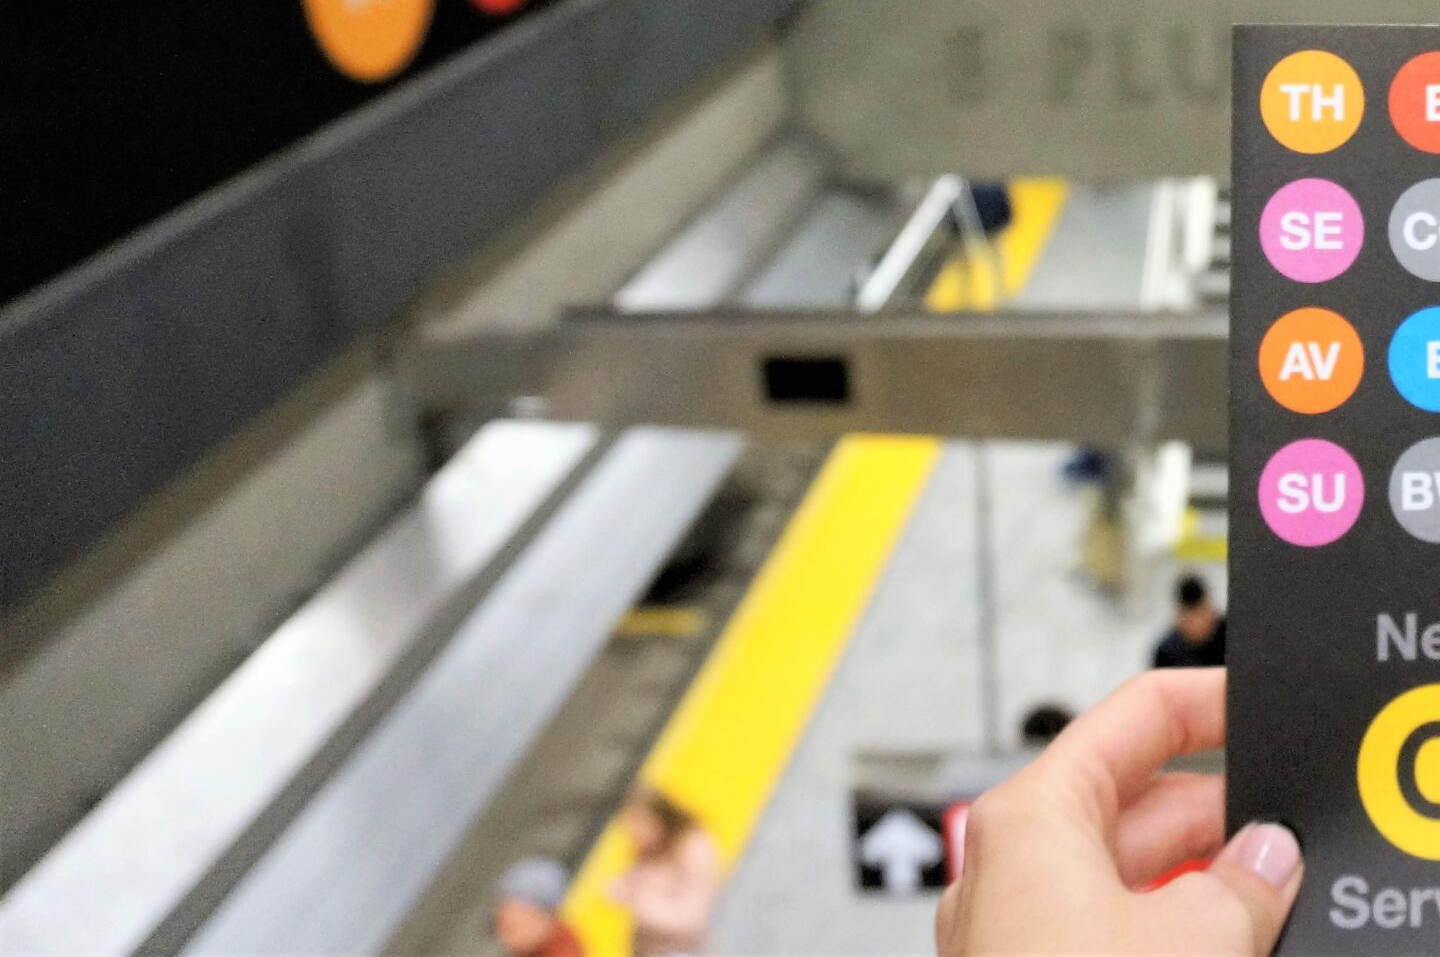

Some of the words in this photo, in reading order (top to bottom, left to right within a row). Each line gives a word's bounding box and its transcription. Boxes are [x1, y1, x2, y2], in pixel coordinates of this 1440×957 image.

[1279, 84, 1345, 122] TH
[1279, 211, 1344, 251] SE
[1278, 342, 1341, 381] AV
[1276, 472, 1346, 514] SU
